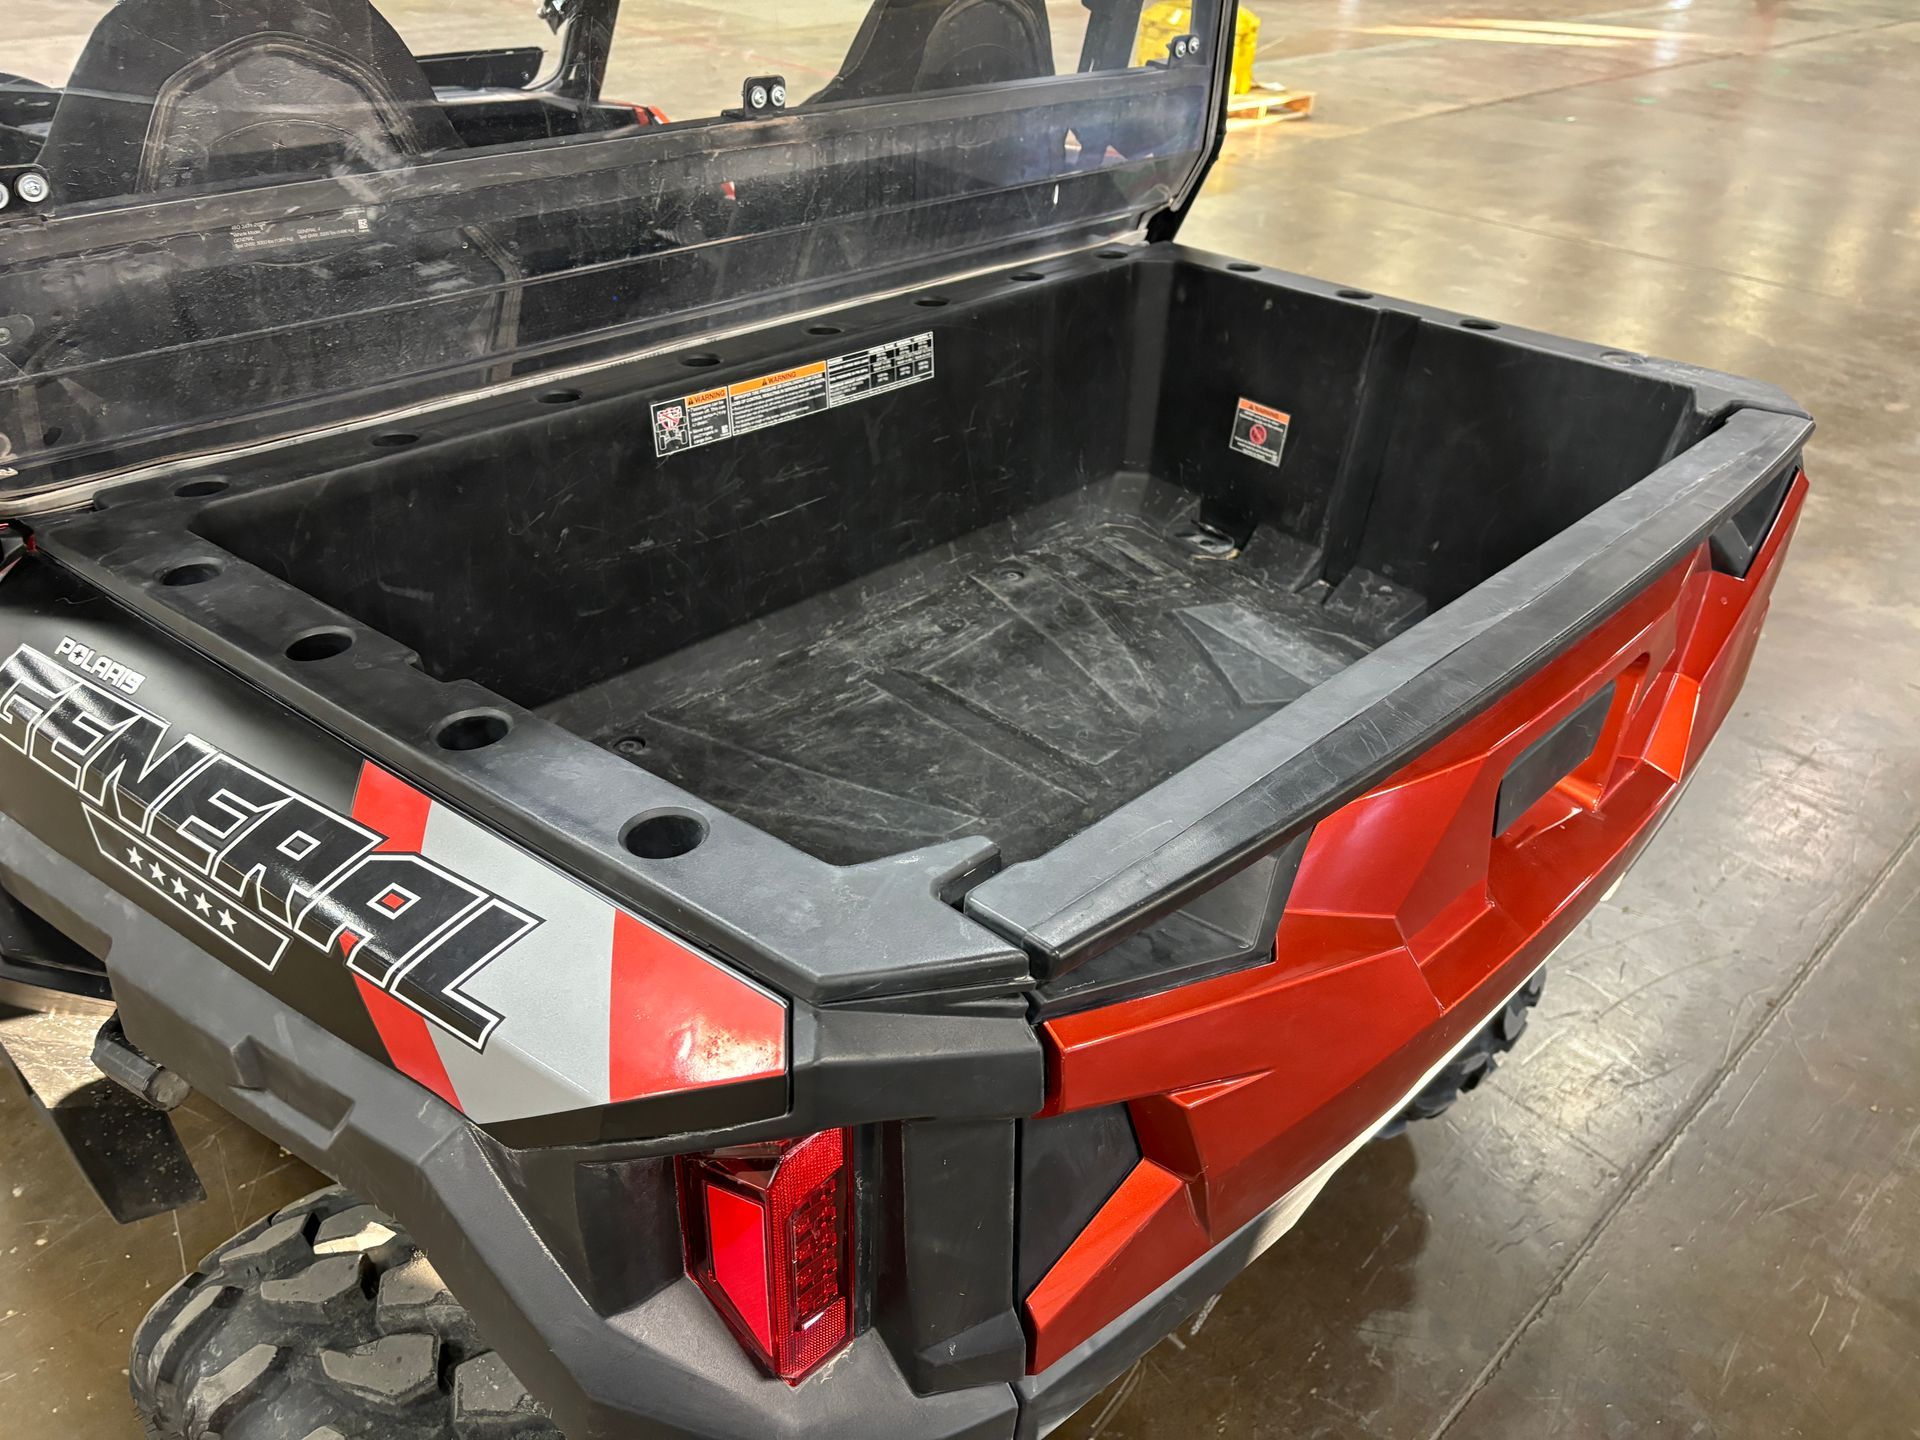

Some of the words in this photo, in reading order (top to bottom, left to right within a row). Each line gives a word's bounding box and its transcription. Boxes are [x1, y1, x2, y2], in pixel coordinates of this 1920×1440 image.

[768, 371, 797, 384] WARNING
[694, 390, 726, 403] WARNING
[54, 636, 146, 696] POLARIS
[0, 643, 545, 1054] GENERAL
